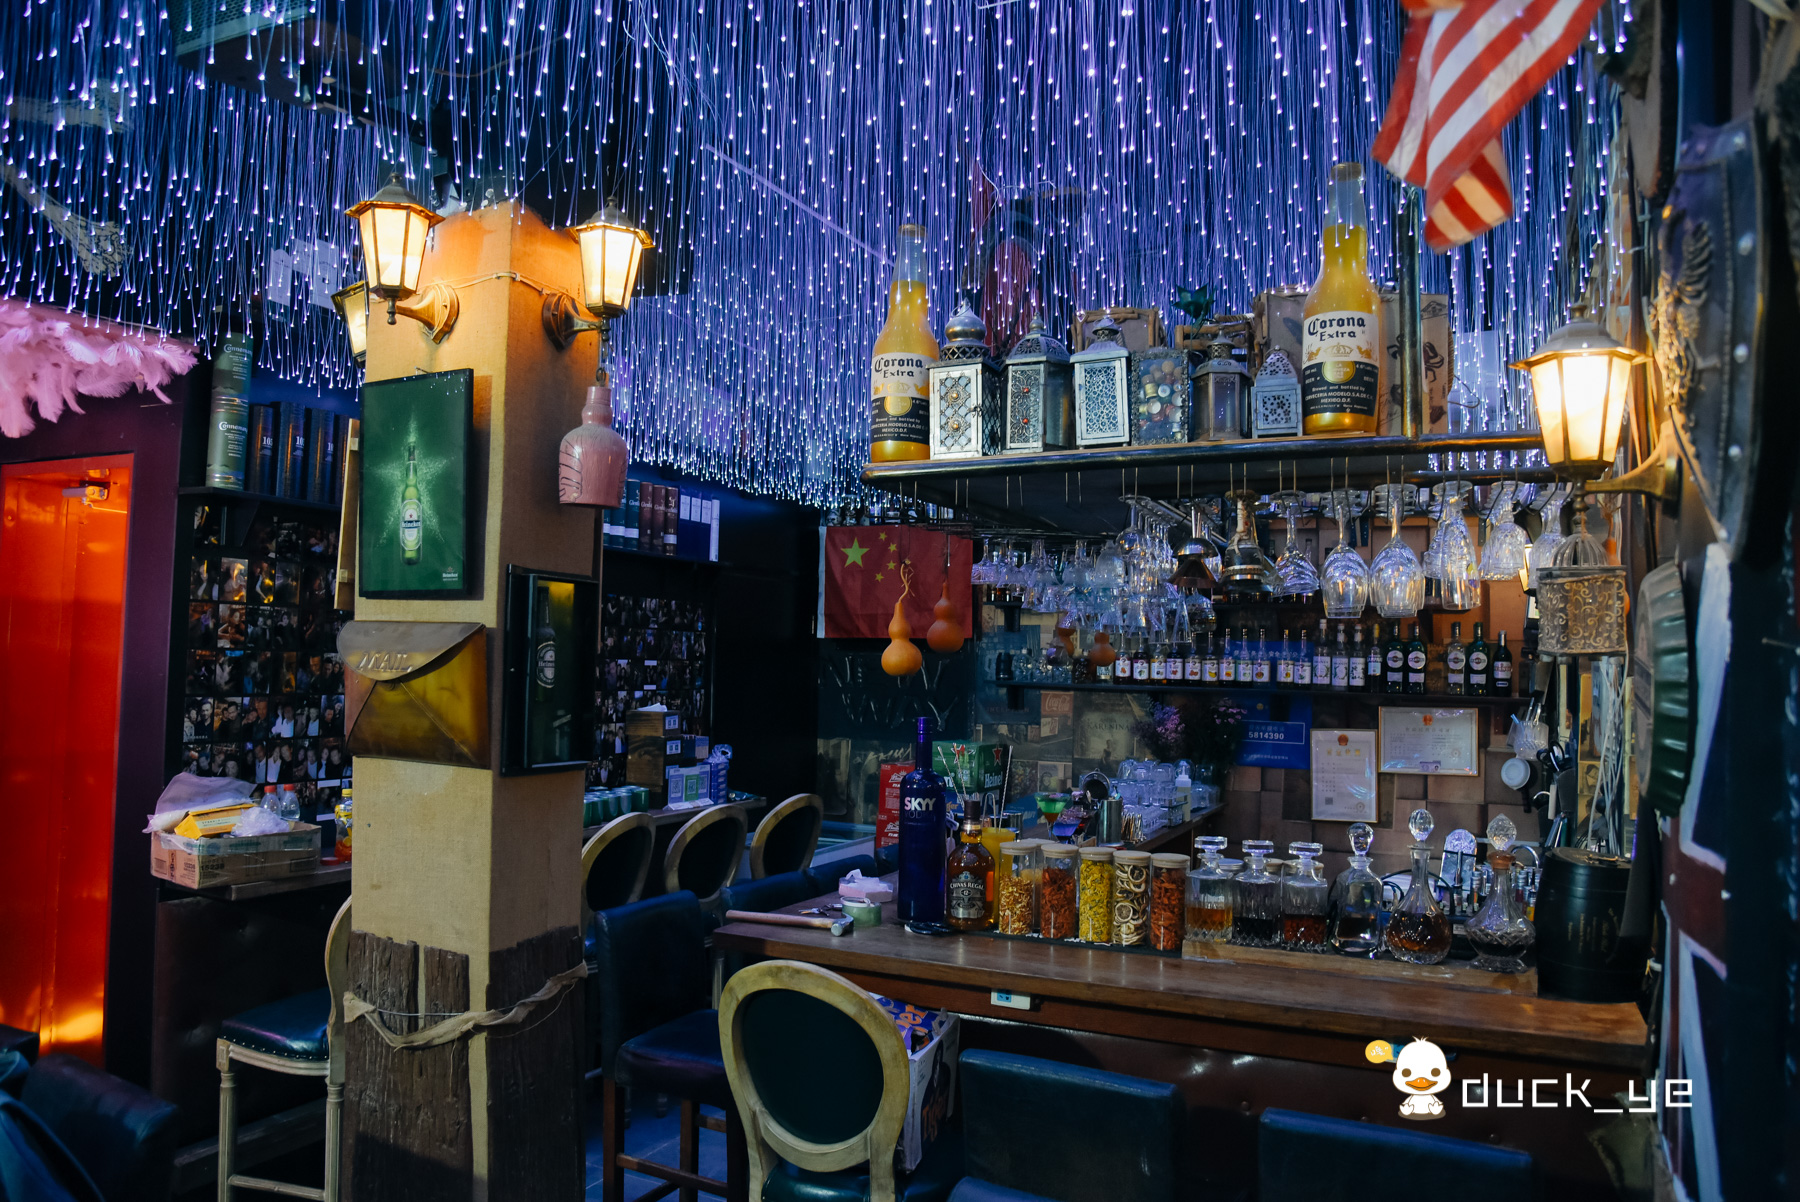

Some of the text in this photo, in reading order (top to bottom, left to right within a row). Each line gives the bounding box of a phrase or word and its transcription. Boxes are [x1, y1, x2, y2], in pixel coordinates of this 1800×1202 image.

[1308, 316, 1366, 337] Corona
[1319, 330, 1357, 342] Extra
[874, 357, 923, 373] Corona
[883, 369, 914, 378] Extra
[356, 651, 412, 672] MAIL
[1248, 731, 1285, 740] 5814390
[904, 796, 937, 811] SKYY
